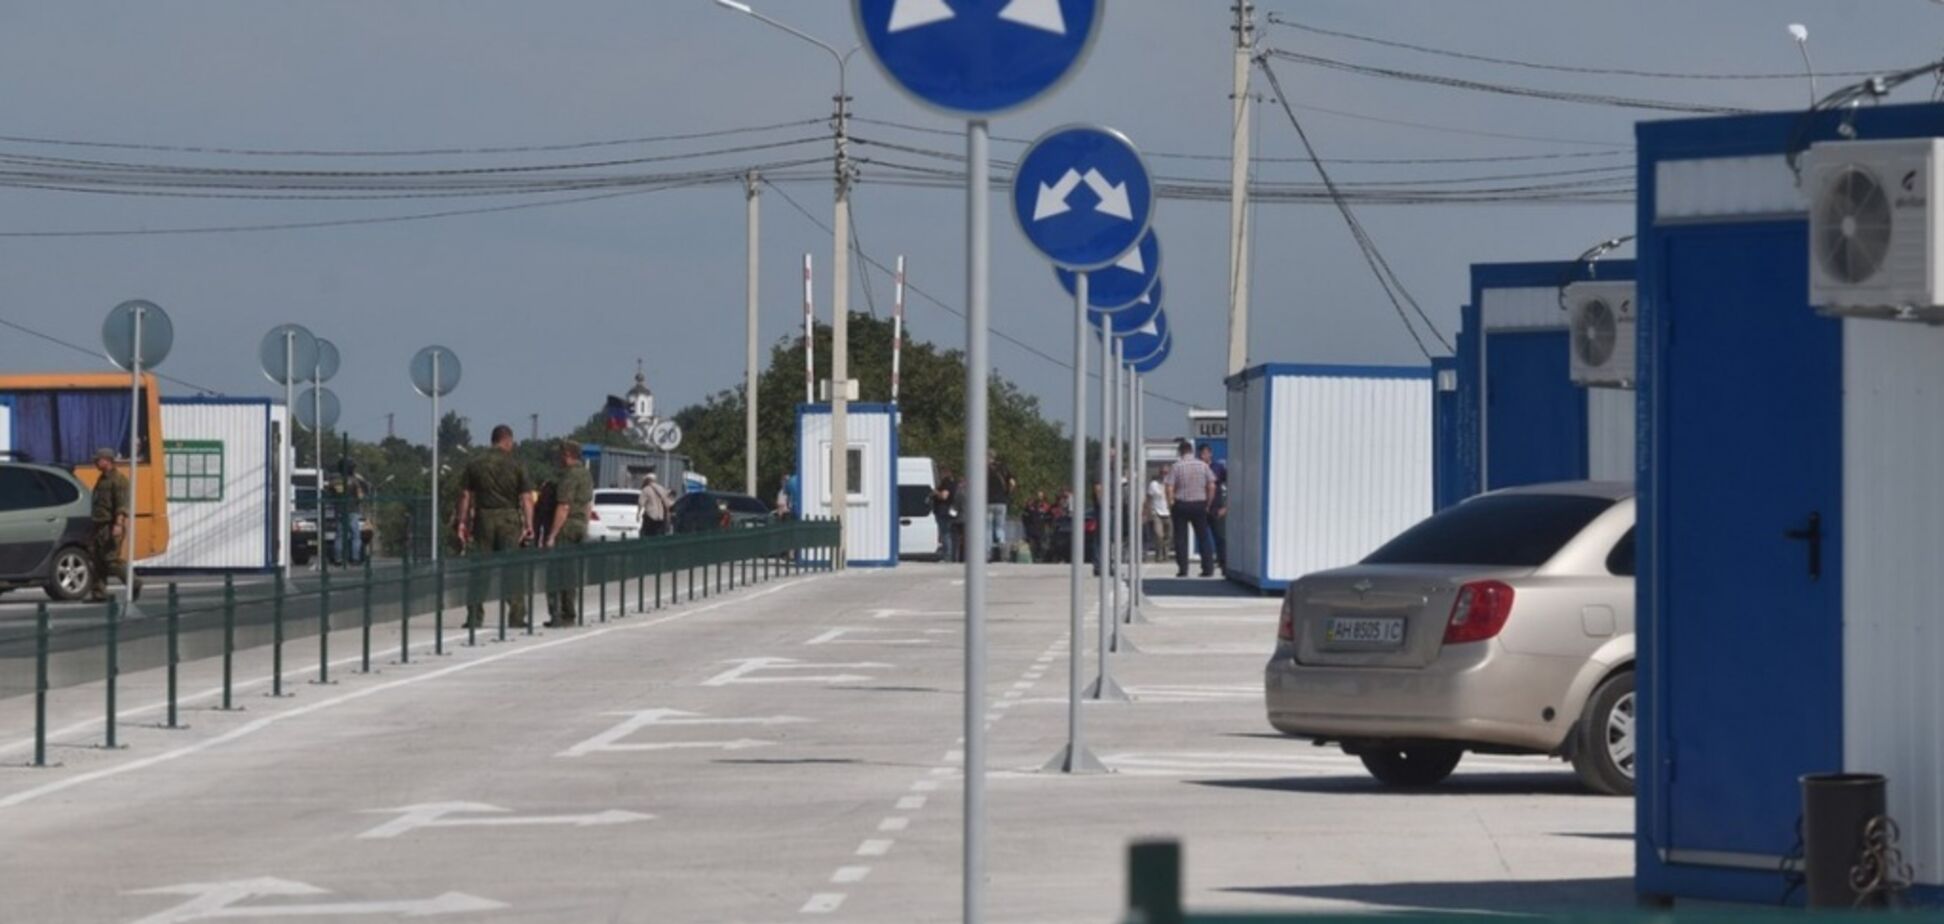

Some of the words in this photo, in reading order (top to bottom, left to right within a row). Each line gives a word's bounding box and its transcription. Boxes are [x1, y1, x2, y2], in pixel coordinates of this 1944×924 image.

[658, 428, 677, 443] 20
[1335, 621, 1352, 639] AH
[1353, 621, 1380, 640] 8505
[1385, 621, 1400, 640] IC
